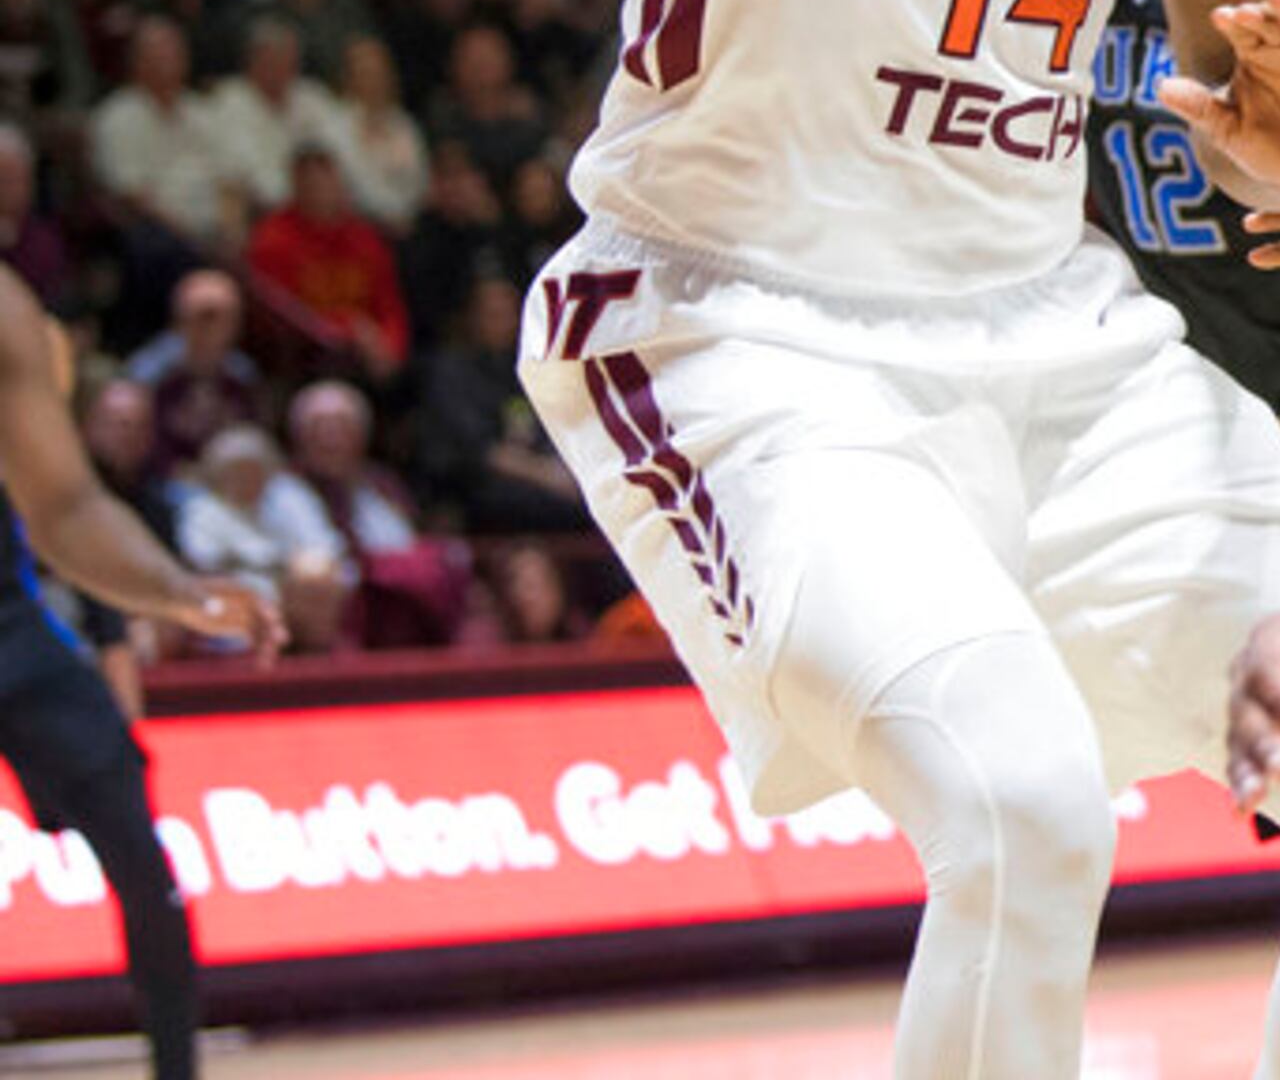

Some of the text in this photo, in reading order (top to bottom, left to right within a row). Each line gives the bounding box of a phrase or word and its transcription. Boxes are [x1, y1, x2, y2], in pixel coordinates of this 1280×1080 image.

[876, 66, 1084, 163] TECH
[1105, 121, 1227, 253] 12
[543, 268, 643, 361] VT
[202, 783, 560, 893] Button.
[553, 759, 729, 865] Get
